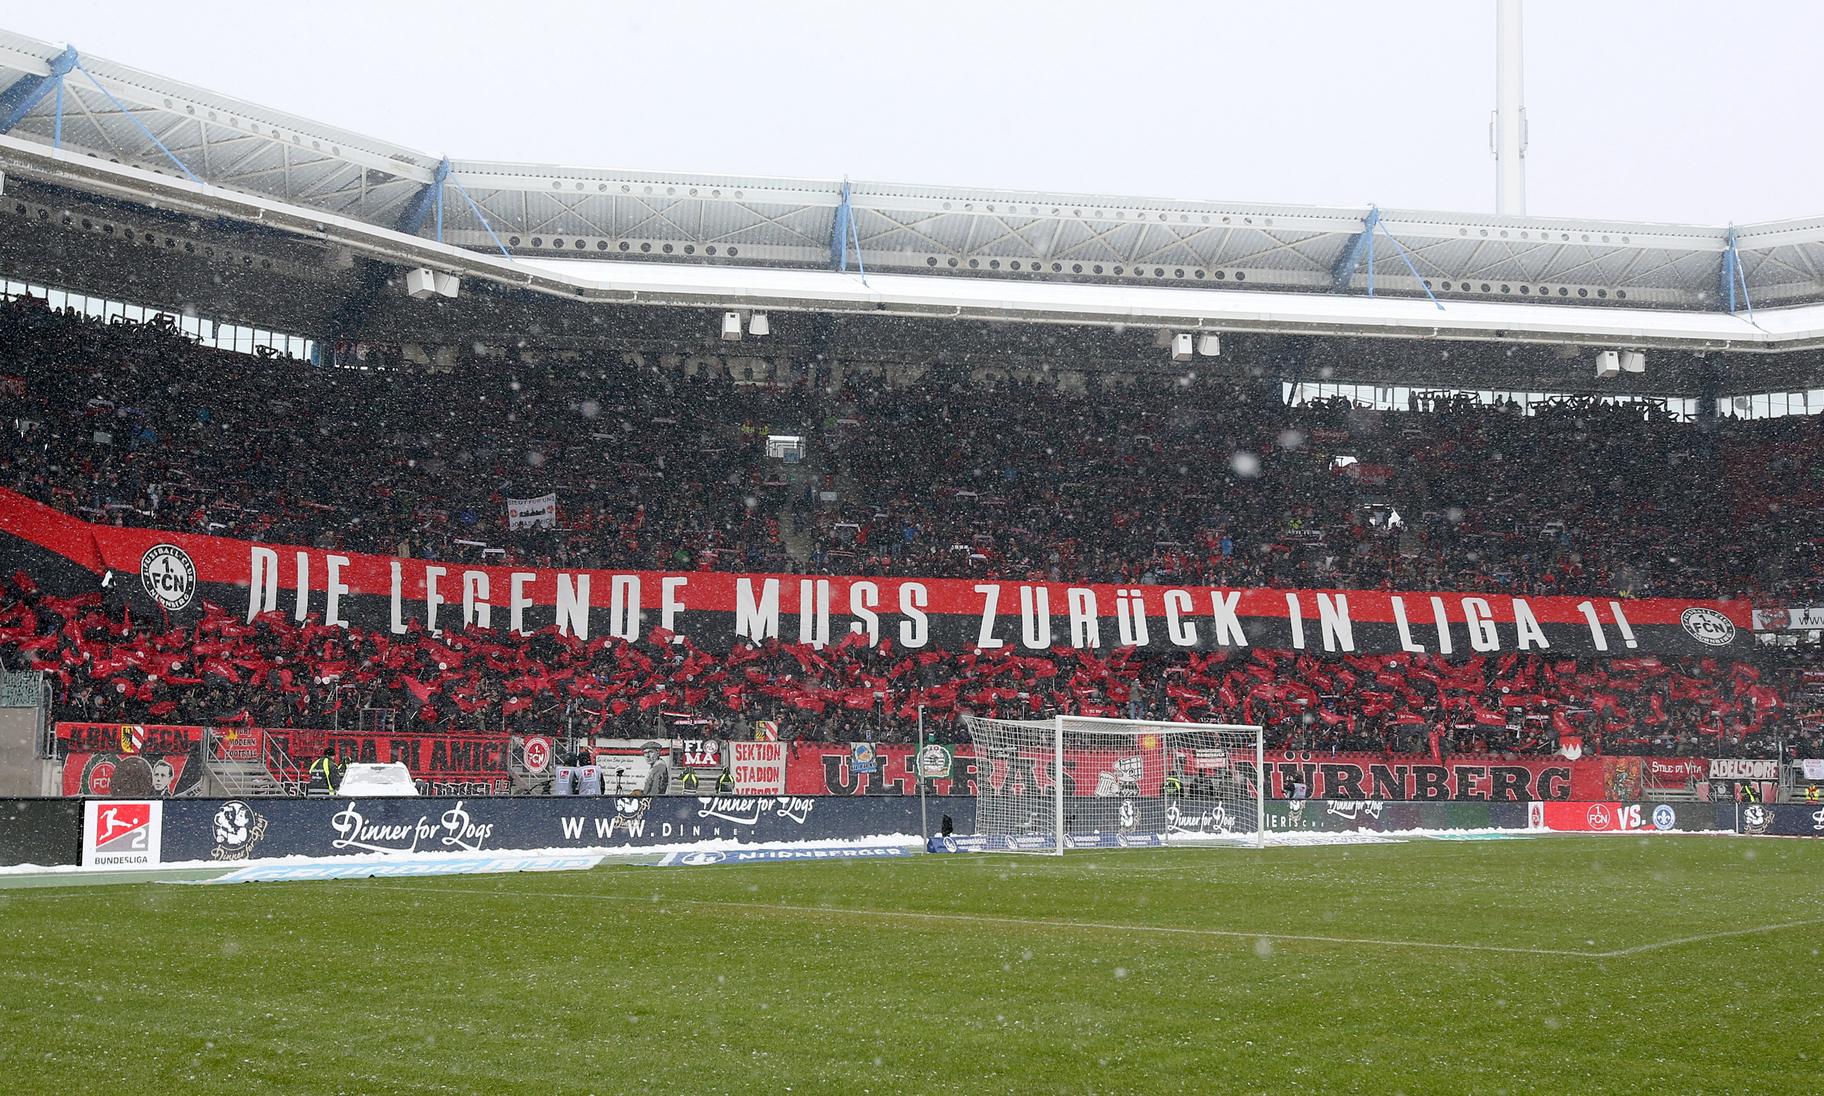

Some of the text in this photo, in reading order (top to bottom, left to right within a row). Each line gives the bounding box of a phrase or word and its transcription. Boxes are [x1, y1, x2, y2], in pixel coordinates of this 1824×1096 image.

[162, 557, 174, 573] 1.
[152, 573, 184, 592] FCN
[247, 547, 1638, 654] DIE LEGENDE MUSS ZURÜCK IN LIGA 1!
[1692, 622, 1726, 634] FCN
[428, 739, 509, 772] AMICI
[735, 743, 781, 761] SEKTION
[735, 766, 779, 783] STADION
[1232, 750, 1572, 800] NÜRNBERG
[1709, 759, 1778, 779] ADELSDORF
[332, 801, 493, 851] Dinner for Dogs
[1617, 805, 1647, 830] VS.
[132, 829, 148, 849] 2
[94, 856, 148, 865] BUNDESLIGA
